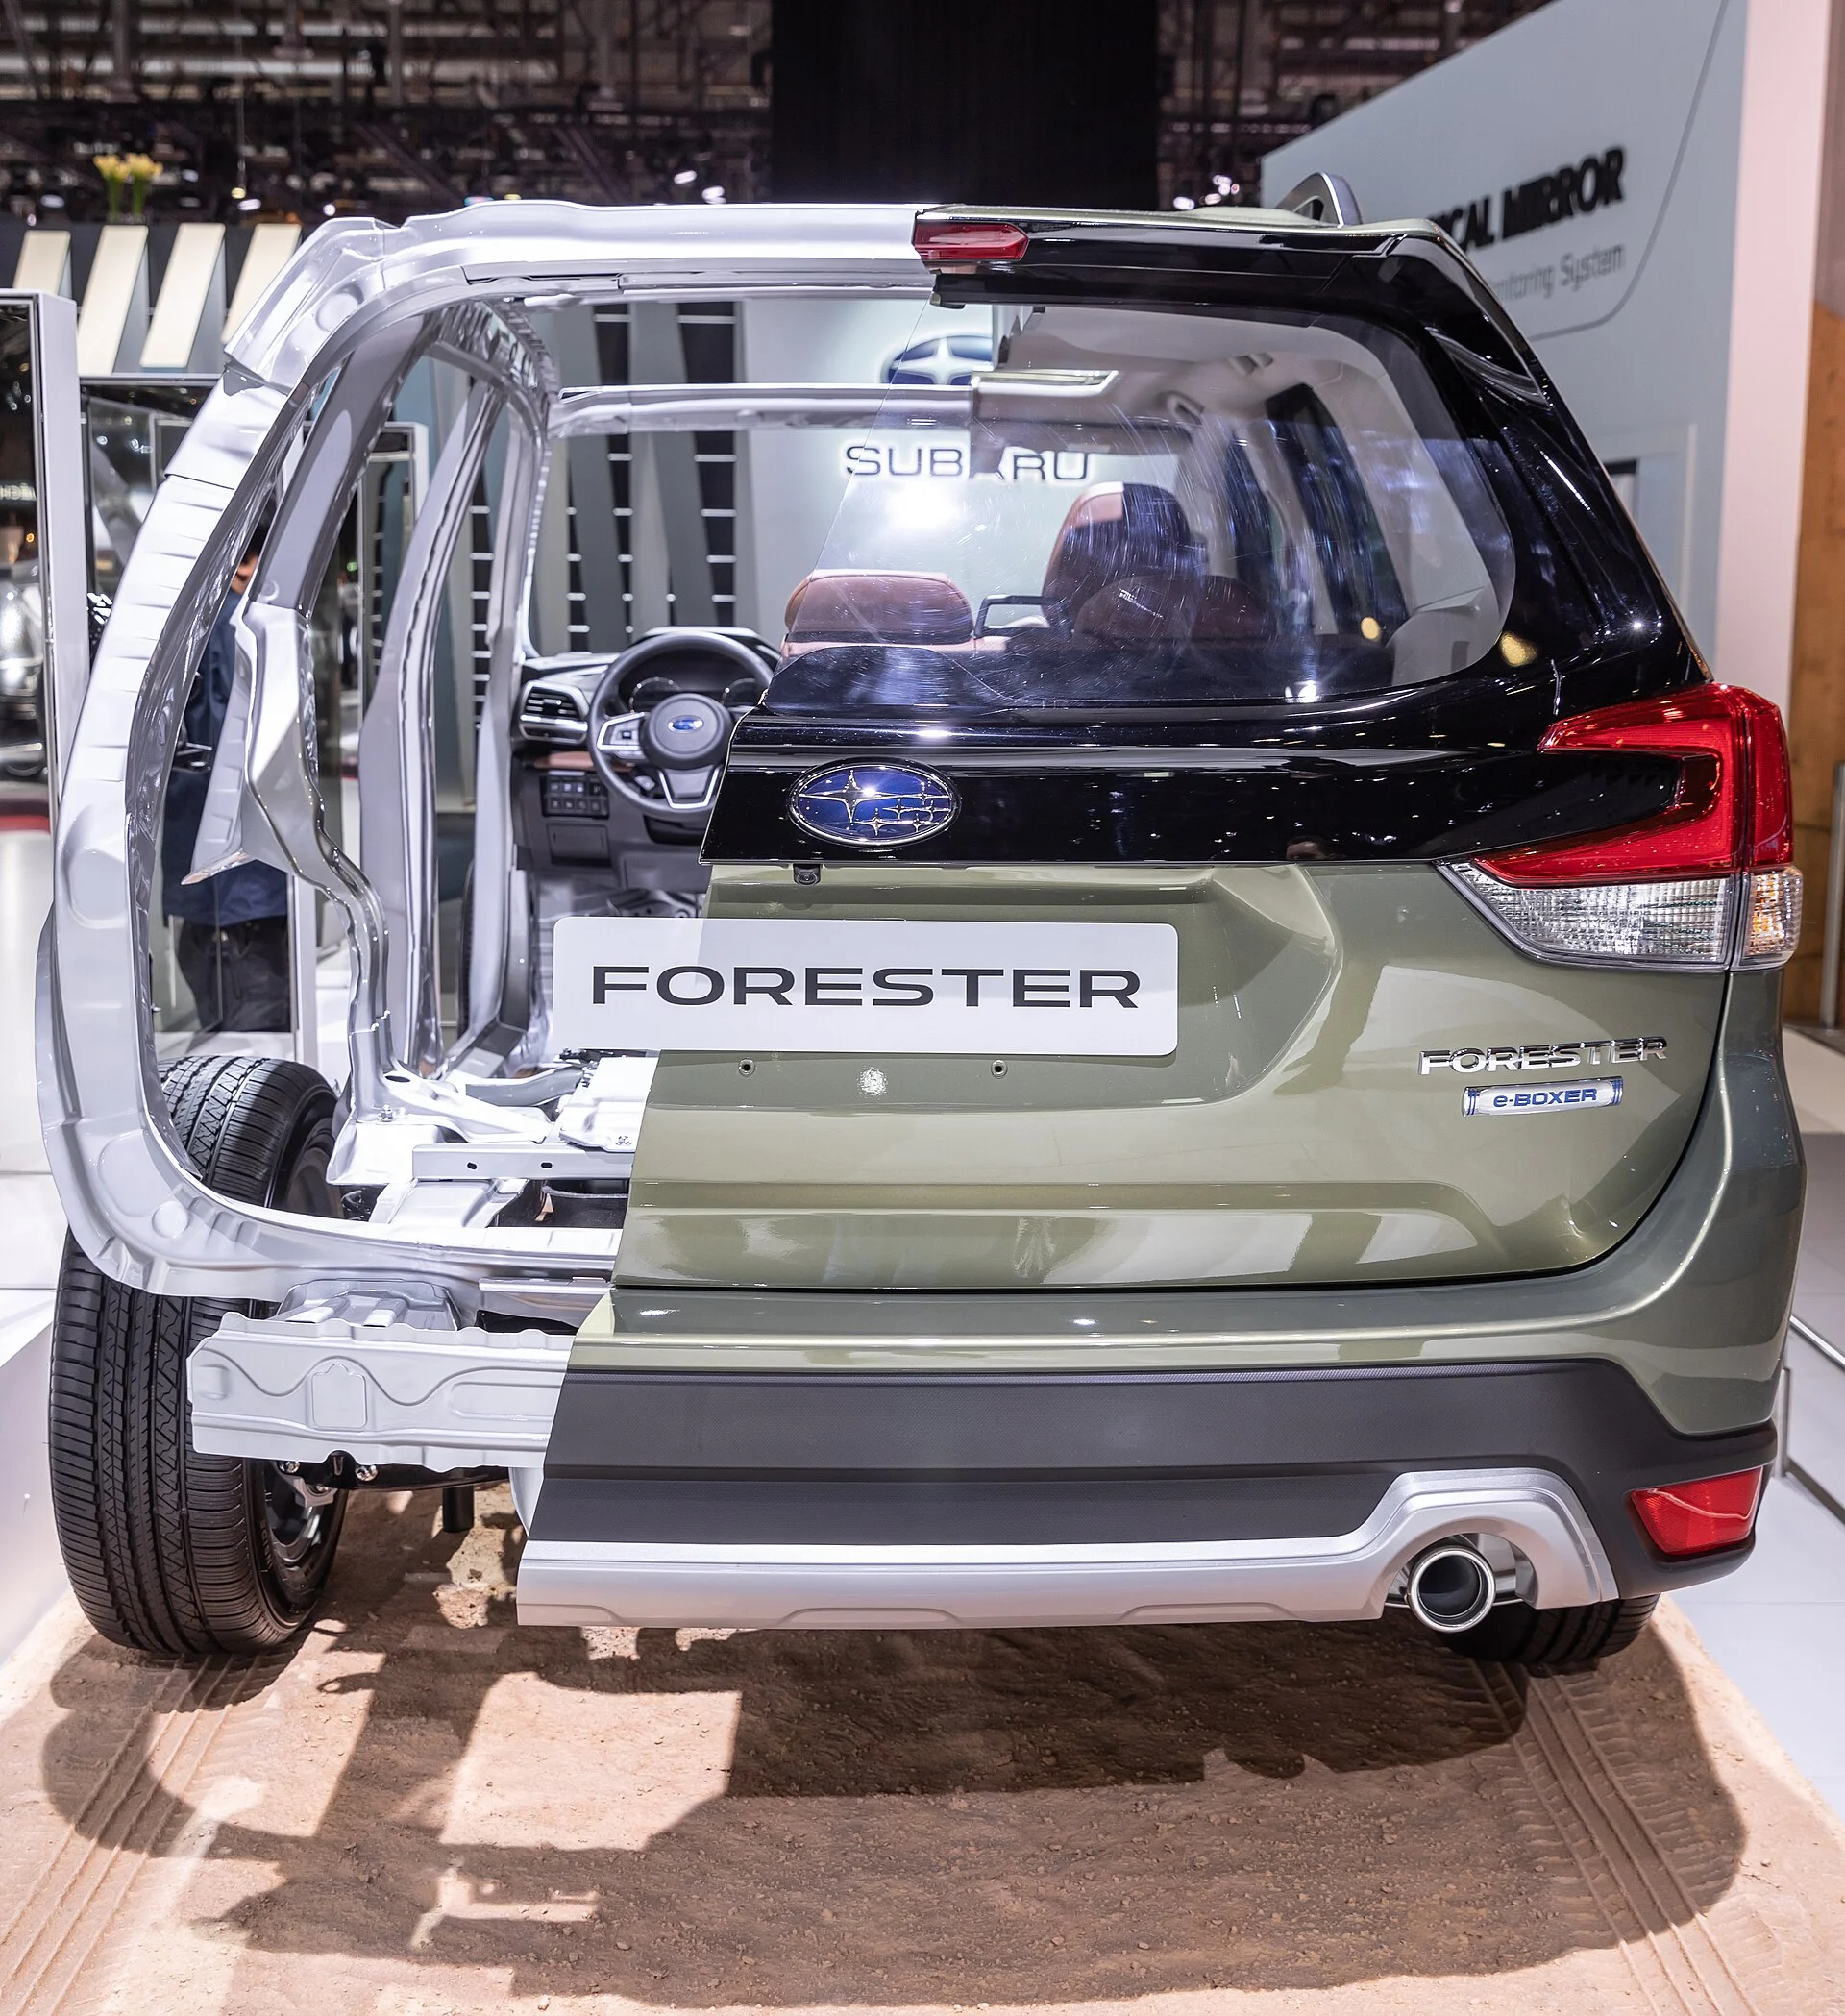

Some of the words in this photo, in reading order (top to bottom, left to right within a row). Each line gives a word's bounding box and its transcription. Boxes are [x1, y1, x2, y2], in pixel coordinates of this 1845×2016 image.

[1501, 147, 1624, 240] MIRROR
[1559, 245, 1625, 292] System
[591, 965, 1142, 1009] FORESTER
[1417, 1036, 1668, 1076] FORESTER
[1492, 1087, 1599, 1109] e-BOXER
